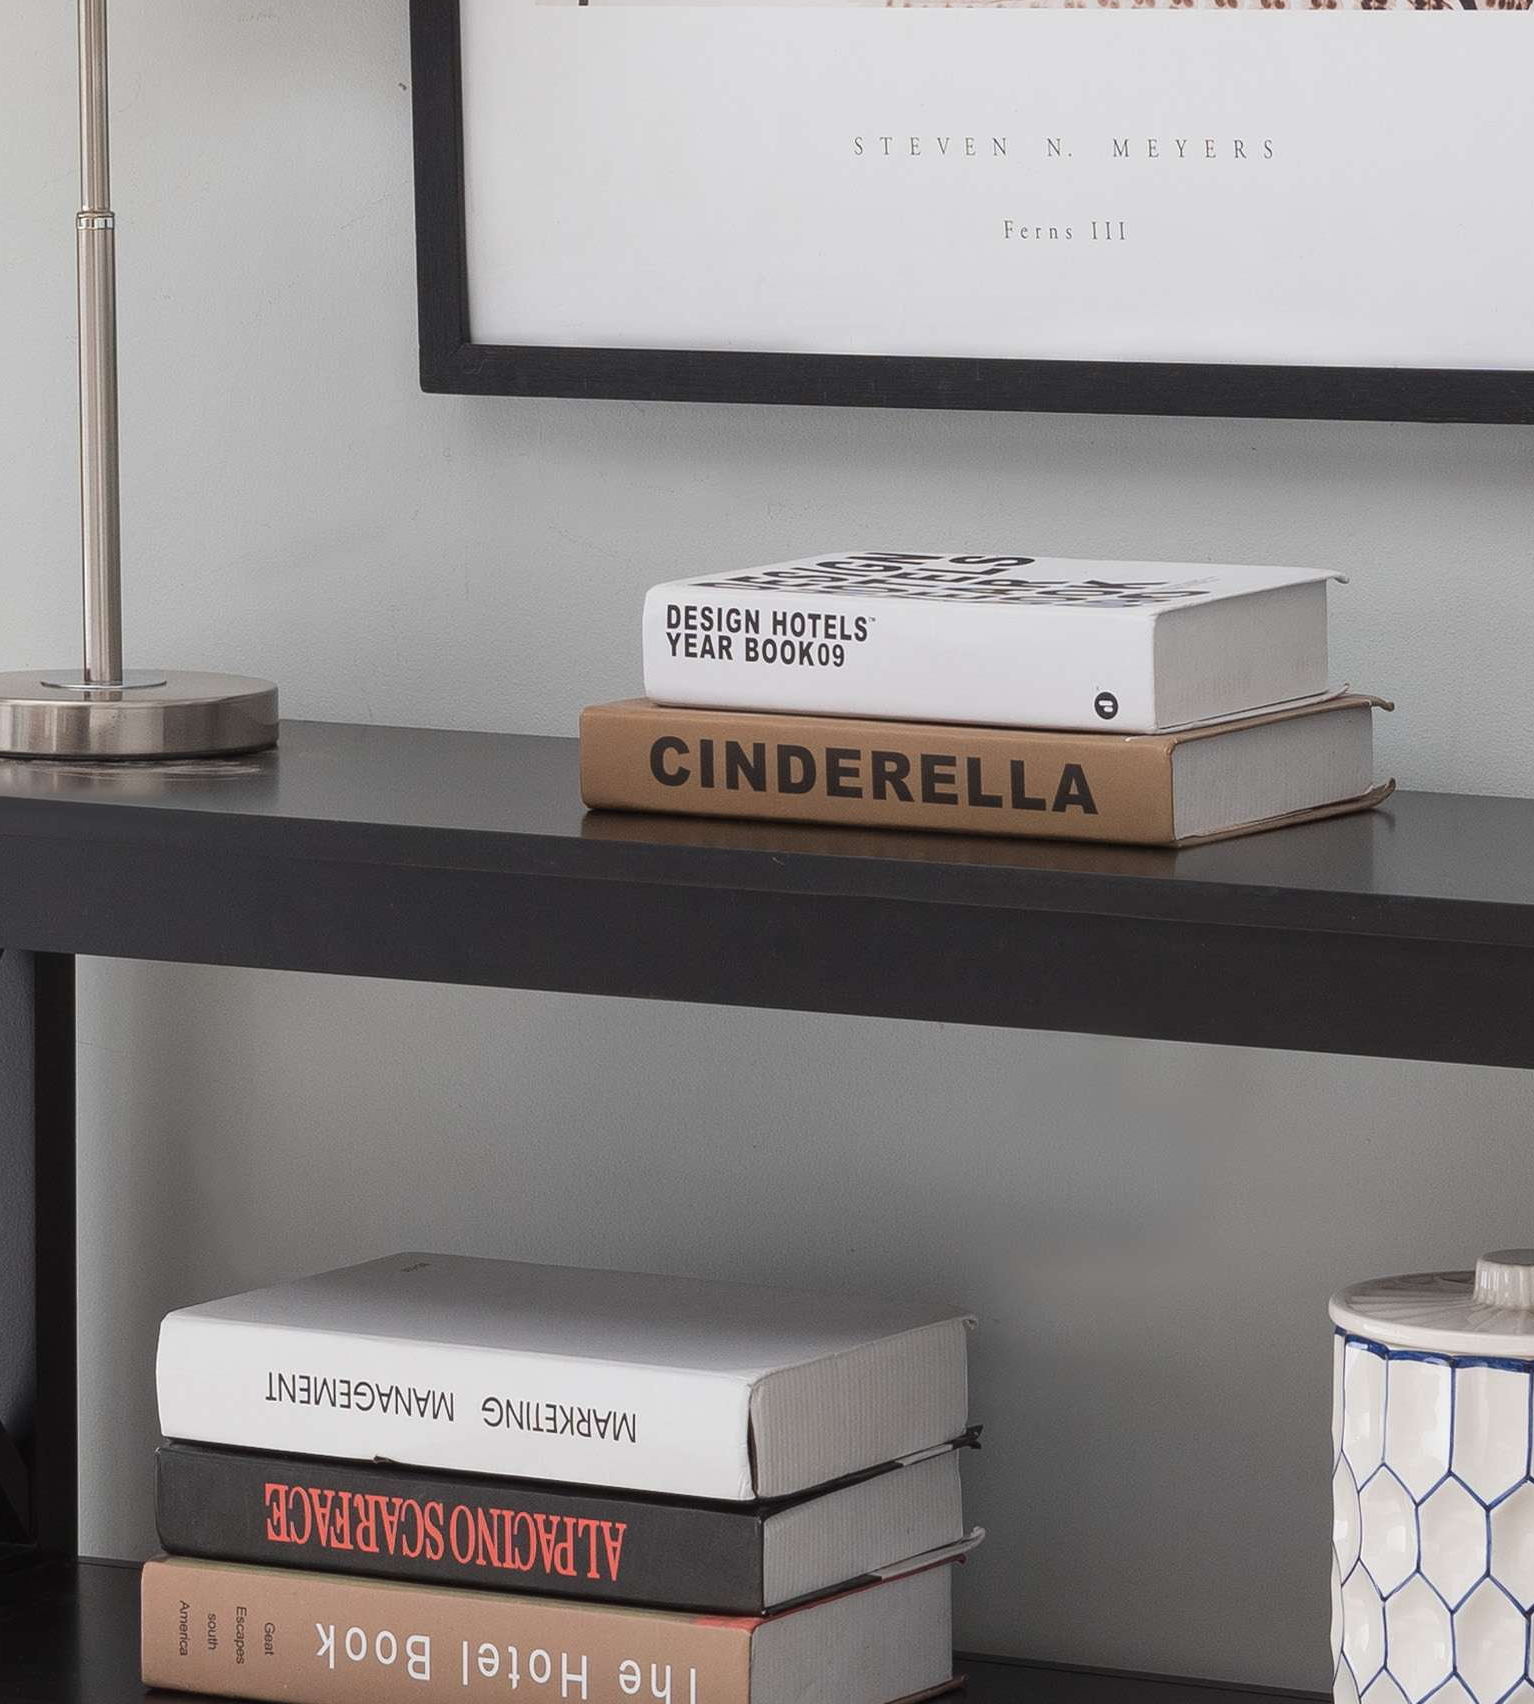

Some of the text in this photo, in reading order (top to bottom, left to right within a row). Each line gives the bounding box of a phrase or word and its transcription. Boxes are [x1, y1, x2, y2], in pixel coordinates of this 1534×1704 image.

[853, 136, 1274, 160] STEVEN N. MEYERS
[1003, 219, 1127, 241] Ferns III
[666, 604, 761, 635] DESIGN
[665, 631, 846, 668] YEAR BOOK09
[649, 735, 1099, 815] CINDERELLA
[265, 1371, 637, 1444] MARKETING MANAGEMENT
[265, 1483, 445, 1562] SCARFACE
[179, 1599, 191, 1657] America
[207, 1612, 219, 1651] south
[233, 1605, 247, 1665] Escapes
[264, 1621, 276, 1656] Geat
[315, 1623, 431, 1681] Book
[461, 1640, 588, 1700] Hotel
